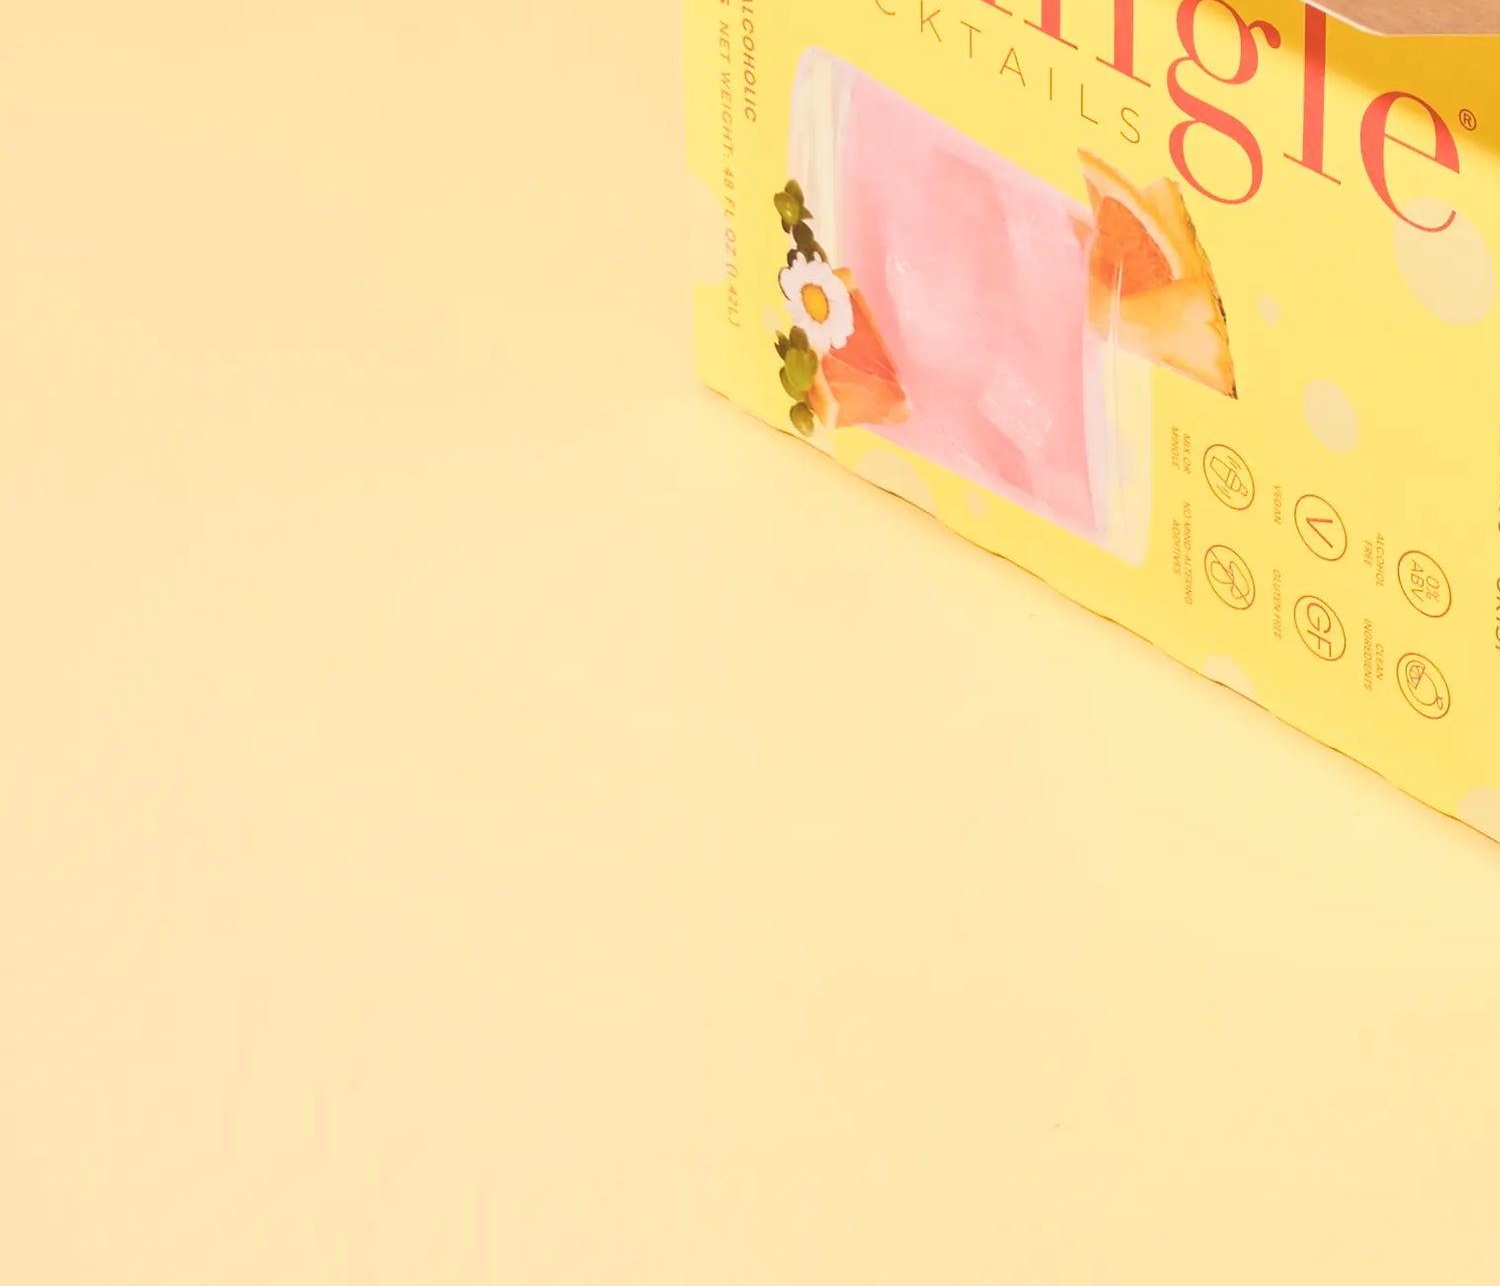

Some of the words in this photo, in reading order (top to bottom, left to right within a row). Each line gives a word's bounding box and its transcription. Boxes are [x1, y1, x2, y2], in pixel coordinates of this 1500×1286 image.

[718, 20, 733, 65] NET
[1375, 531, 1385, 588] ALCOHOL
[1409, 558, 1426, 604] ABV
[1305, 601, 1334, 659] GF
[1374, 642, 1385, 682] CLEAN
